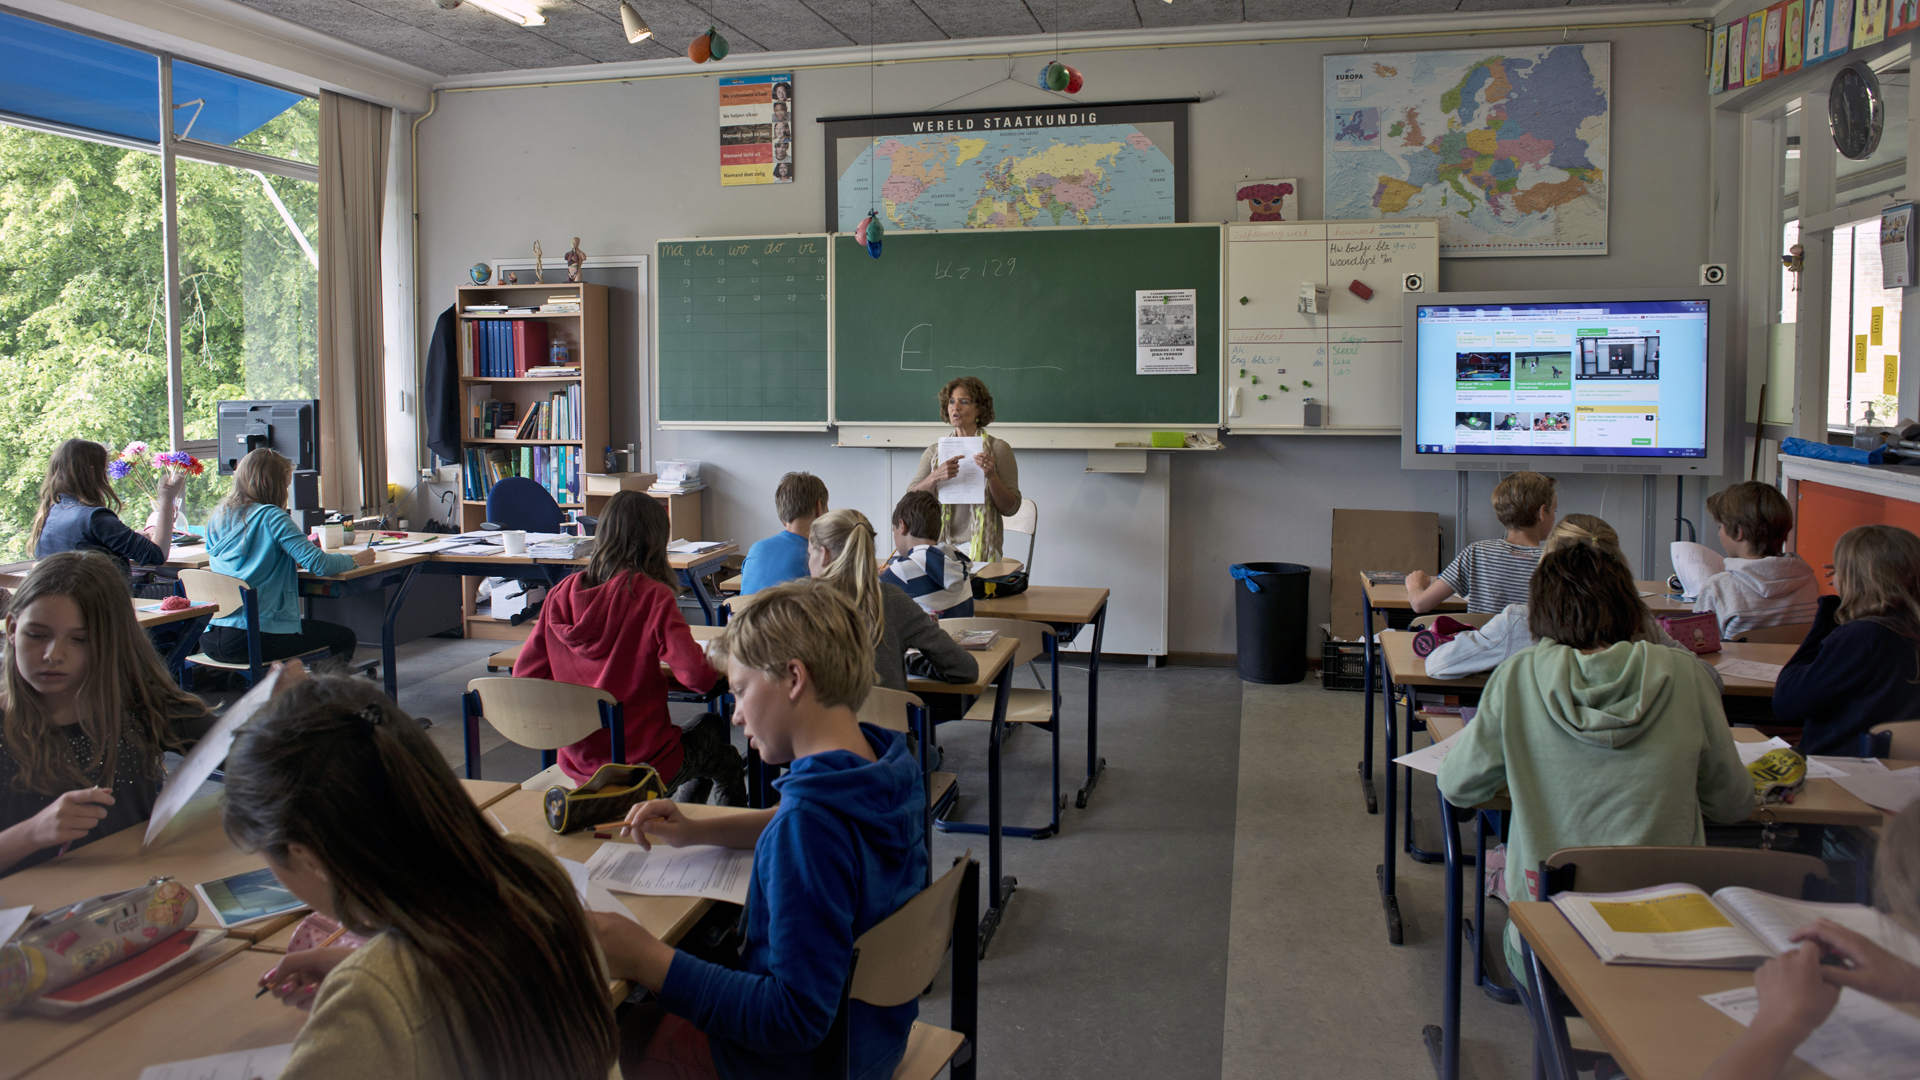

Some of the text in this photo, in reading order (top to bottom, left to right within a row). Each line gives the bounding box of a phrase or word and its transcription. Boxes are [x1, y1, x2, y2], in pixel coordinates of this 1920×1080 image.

[913, 112, 1097, 132] WERELD STAATKUNDIG
[662, 244, 685, 257] ma
[696, 244, 715, 257] di
[728, 244, 750, 256] wo
[764, 242, 786, 255] do
[683, 258, 691, 266] 12
[817, 256, 826, 264] 16
[982, 257, 1016, 278] 129
[683, 279, 691, 288] 19
[1267, 355, 1281, 364] 59
